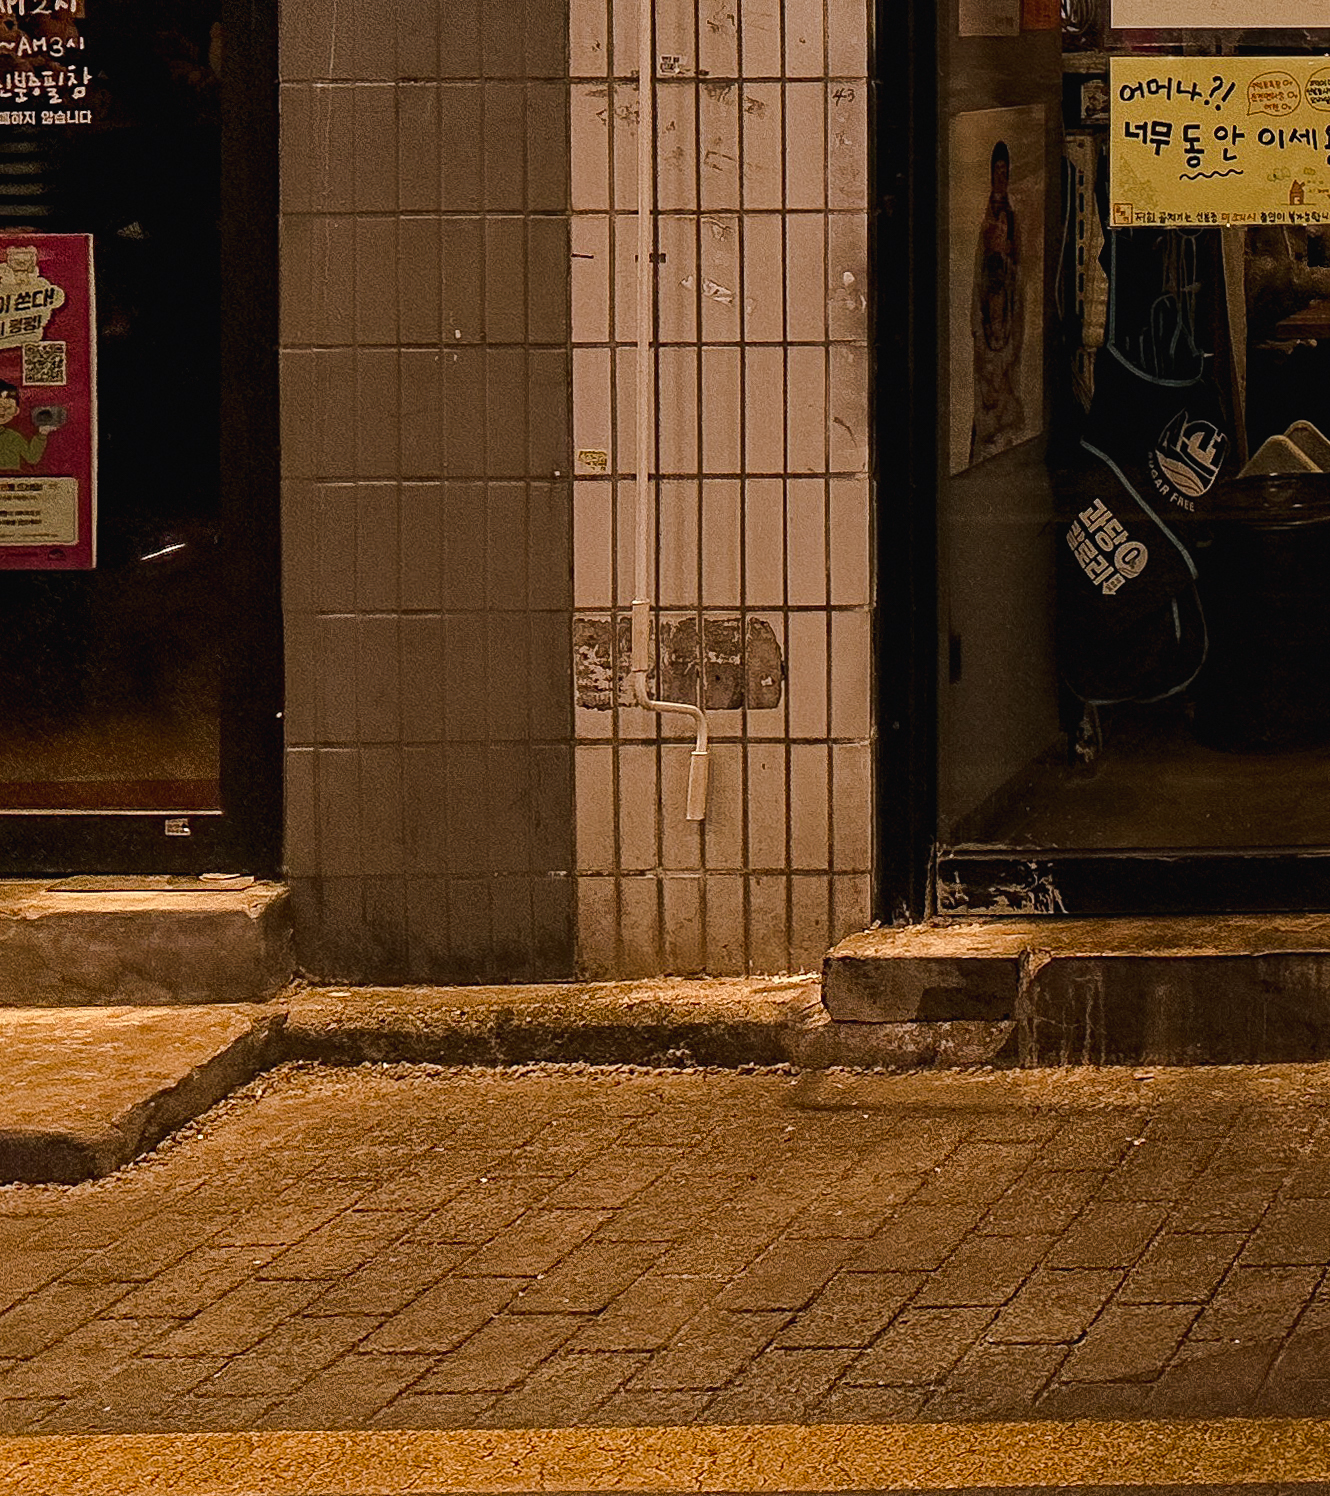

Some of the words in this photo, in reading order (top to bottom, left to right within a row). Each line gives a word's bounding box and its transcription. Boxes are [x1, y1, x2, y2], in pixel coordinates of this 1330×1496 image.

[1120, 75, 1236, 111] 어머나?!
[41, 110, 92, 125] 않습니다
[1124, 121, 1172, 156] 너무
